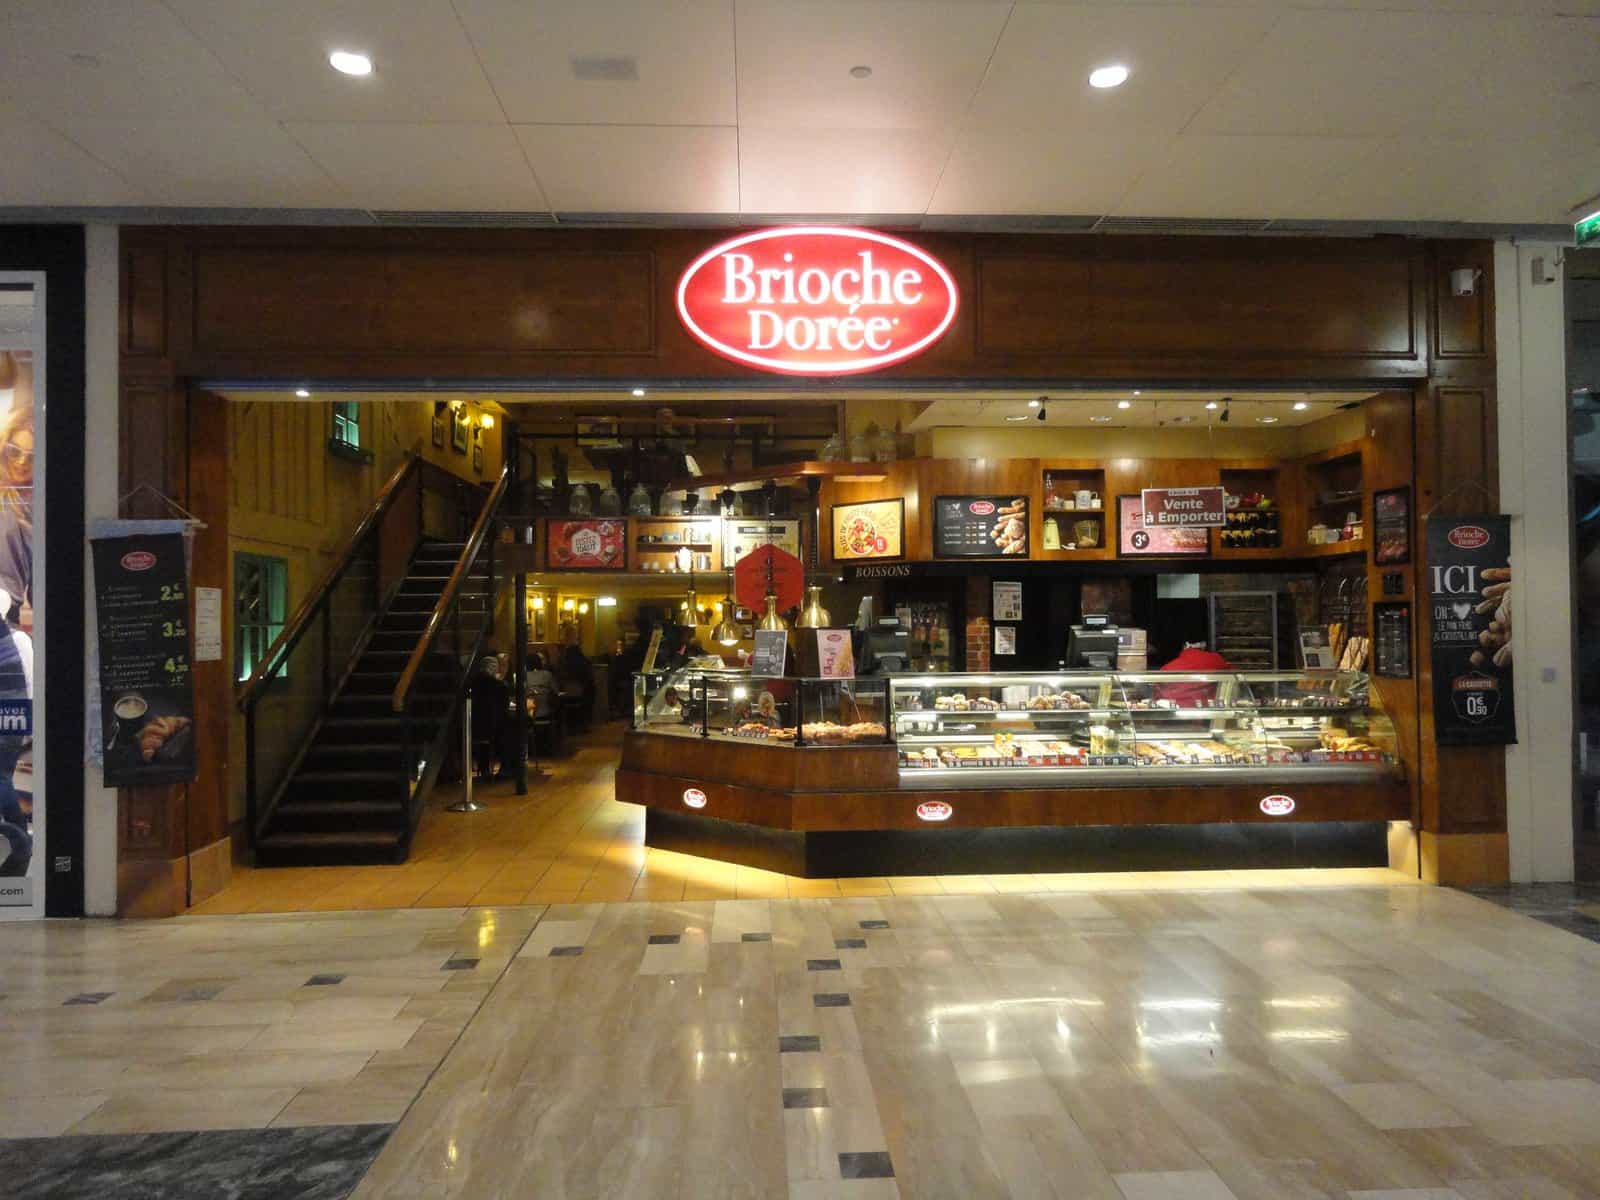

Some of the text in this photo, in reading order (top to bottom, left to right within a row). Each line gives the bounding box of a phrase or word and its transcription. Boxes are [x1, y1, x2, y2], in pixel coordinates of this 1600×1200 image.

[721, 249, 922, 305] Brioche
[747, 299, 891, 351] Dorée
[1163, 498, 1204, 510] Vente
[1146, 512, 1154, 523] à
[1158, 511, 1222, 526] Emporter
[855, 564, 911, 578] BOISSONS
[1430, 564, 1479, 594] ICI
